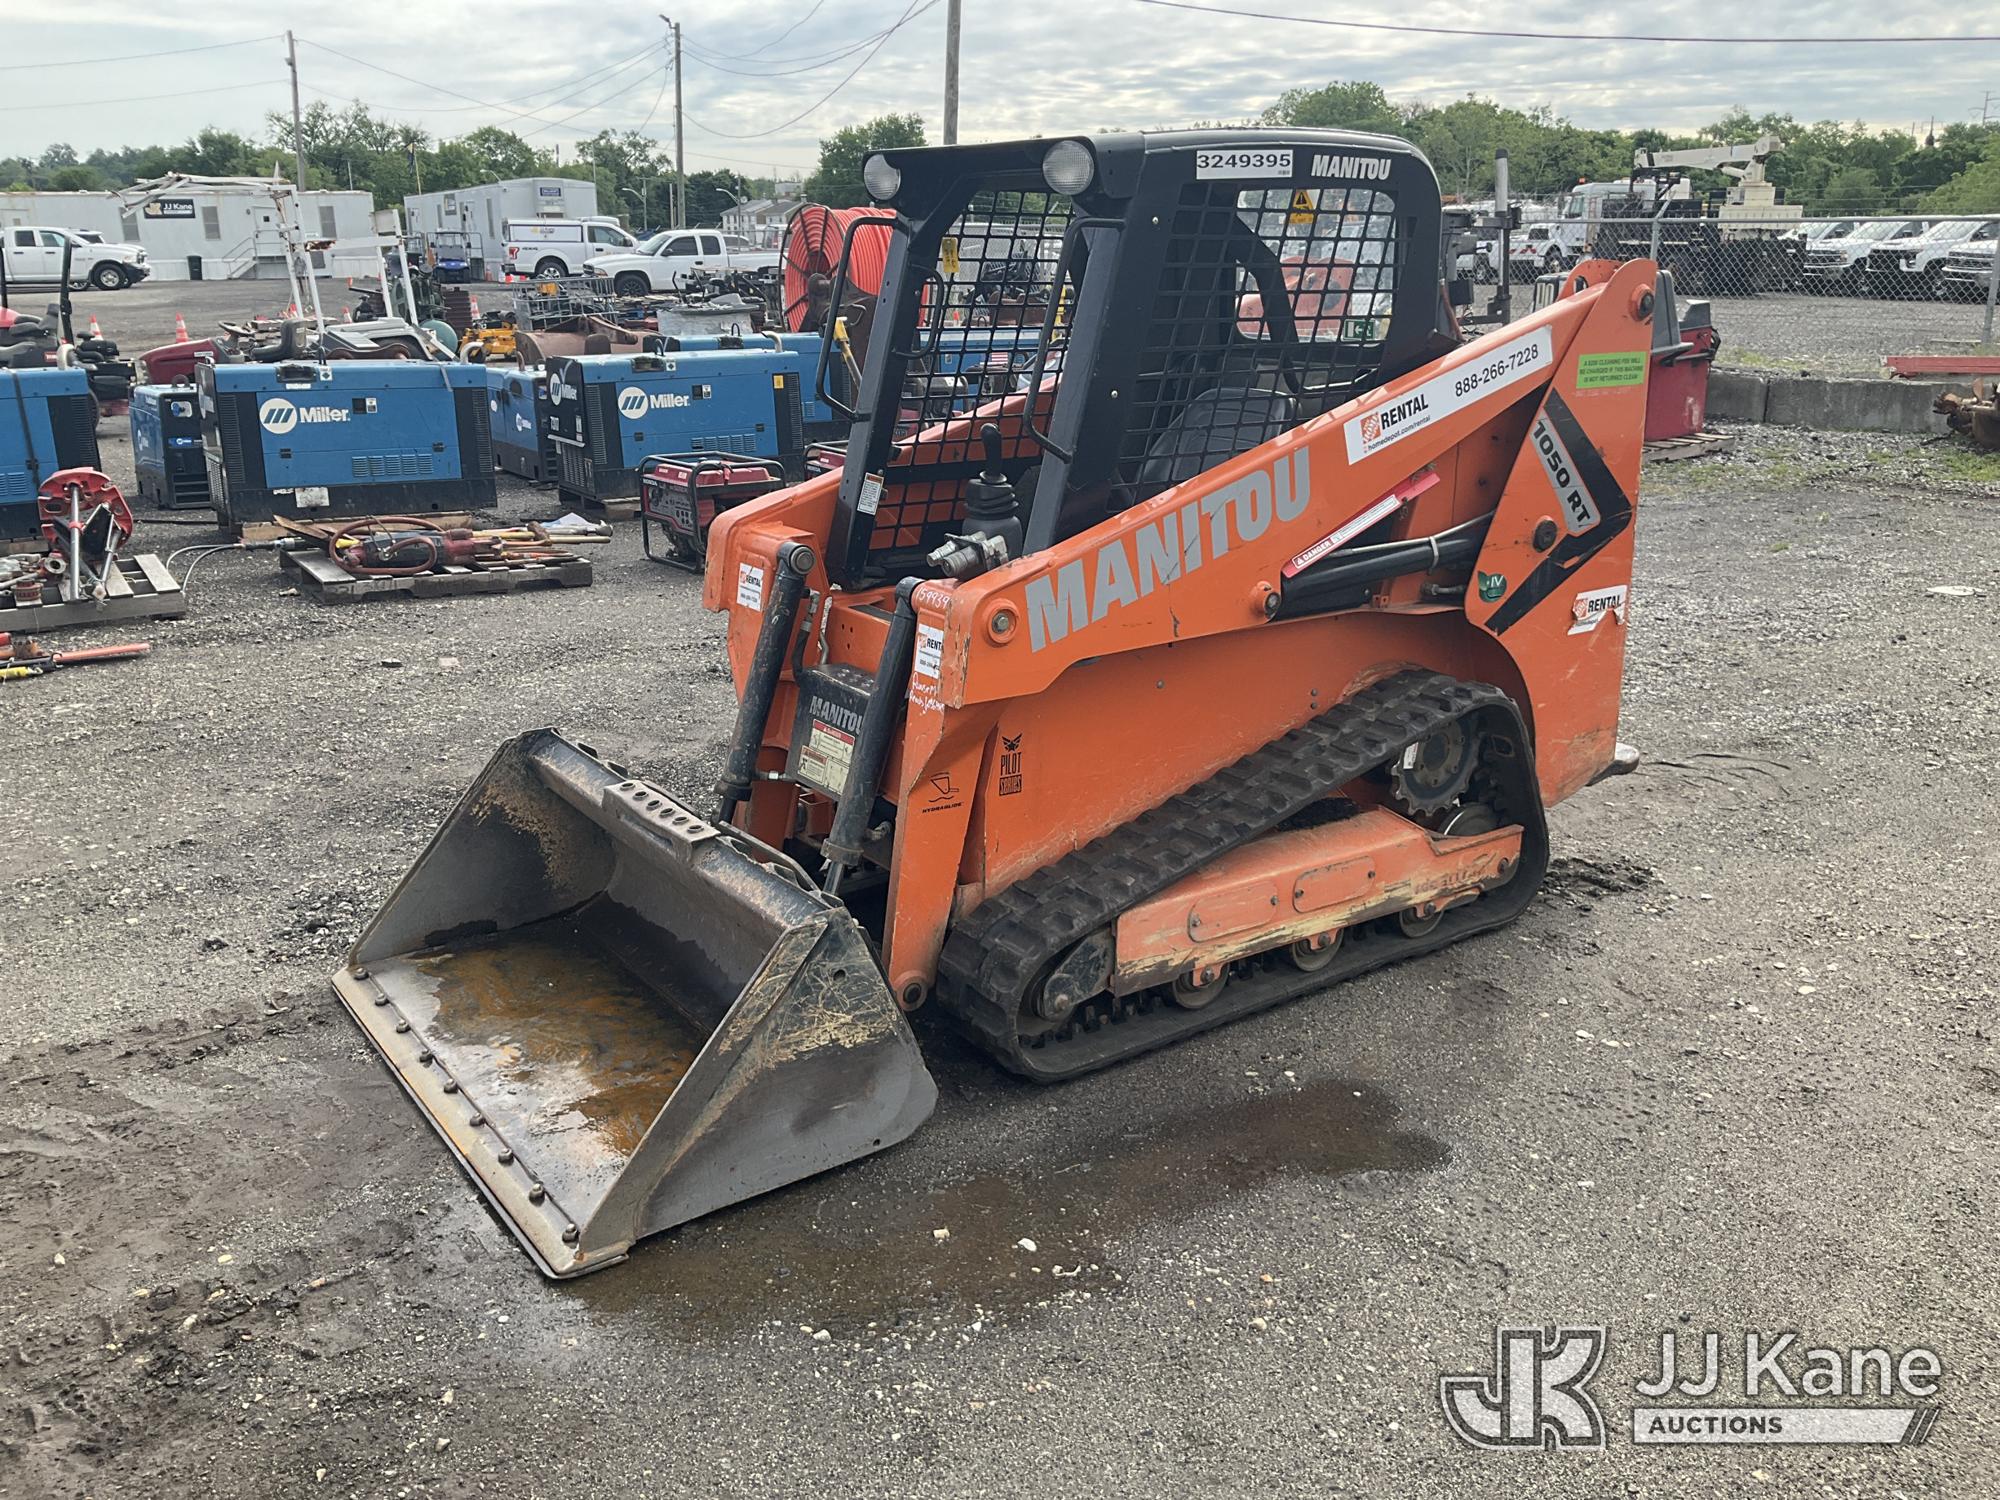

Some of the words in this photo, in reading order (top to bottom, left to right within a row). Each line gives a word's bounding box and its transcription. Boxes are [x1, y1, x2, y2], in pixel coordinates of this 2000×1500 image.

[1197, 153, 1291, 169] 3249395
[1311, 154, 1392, 181] MANITOU
[1454, 343, 1540, 398] 888-266-7228
[649, 393, 690, 410] Miller
[1381, 393, 1429, 430] RENTAL
[299, 406, 350, 424] Miller
[1532, 420, 1571, 489] 1050
[1566, 489, 1591, 523] RT
[1024, 445, 1311, 654] MANITOU
[1302, 540, 1332, 562] DANGER
[1587, 594, 1622, 614] RENTAL
[1000, 751, 1022, 777] PILOT
[1001, 777, 1021, 794] SERIES
